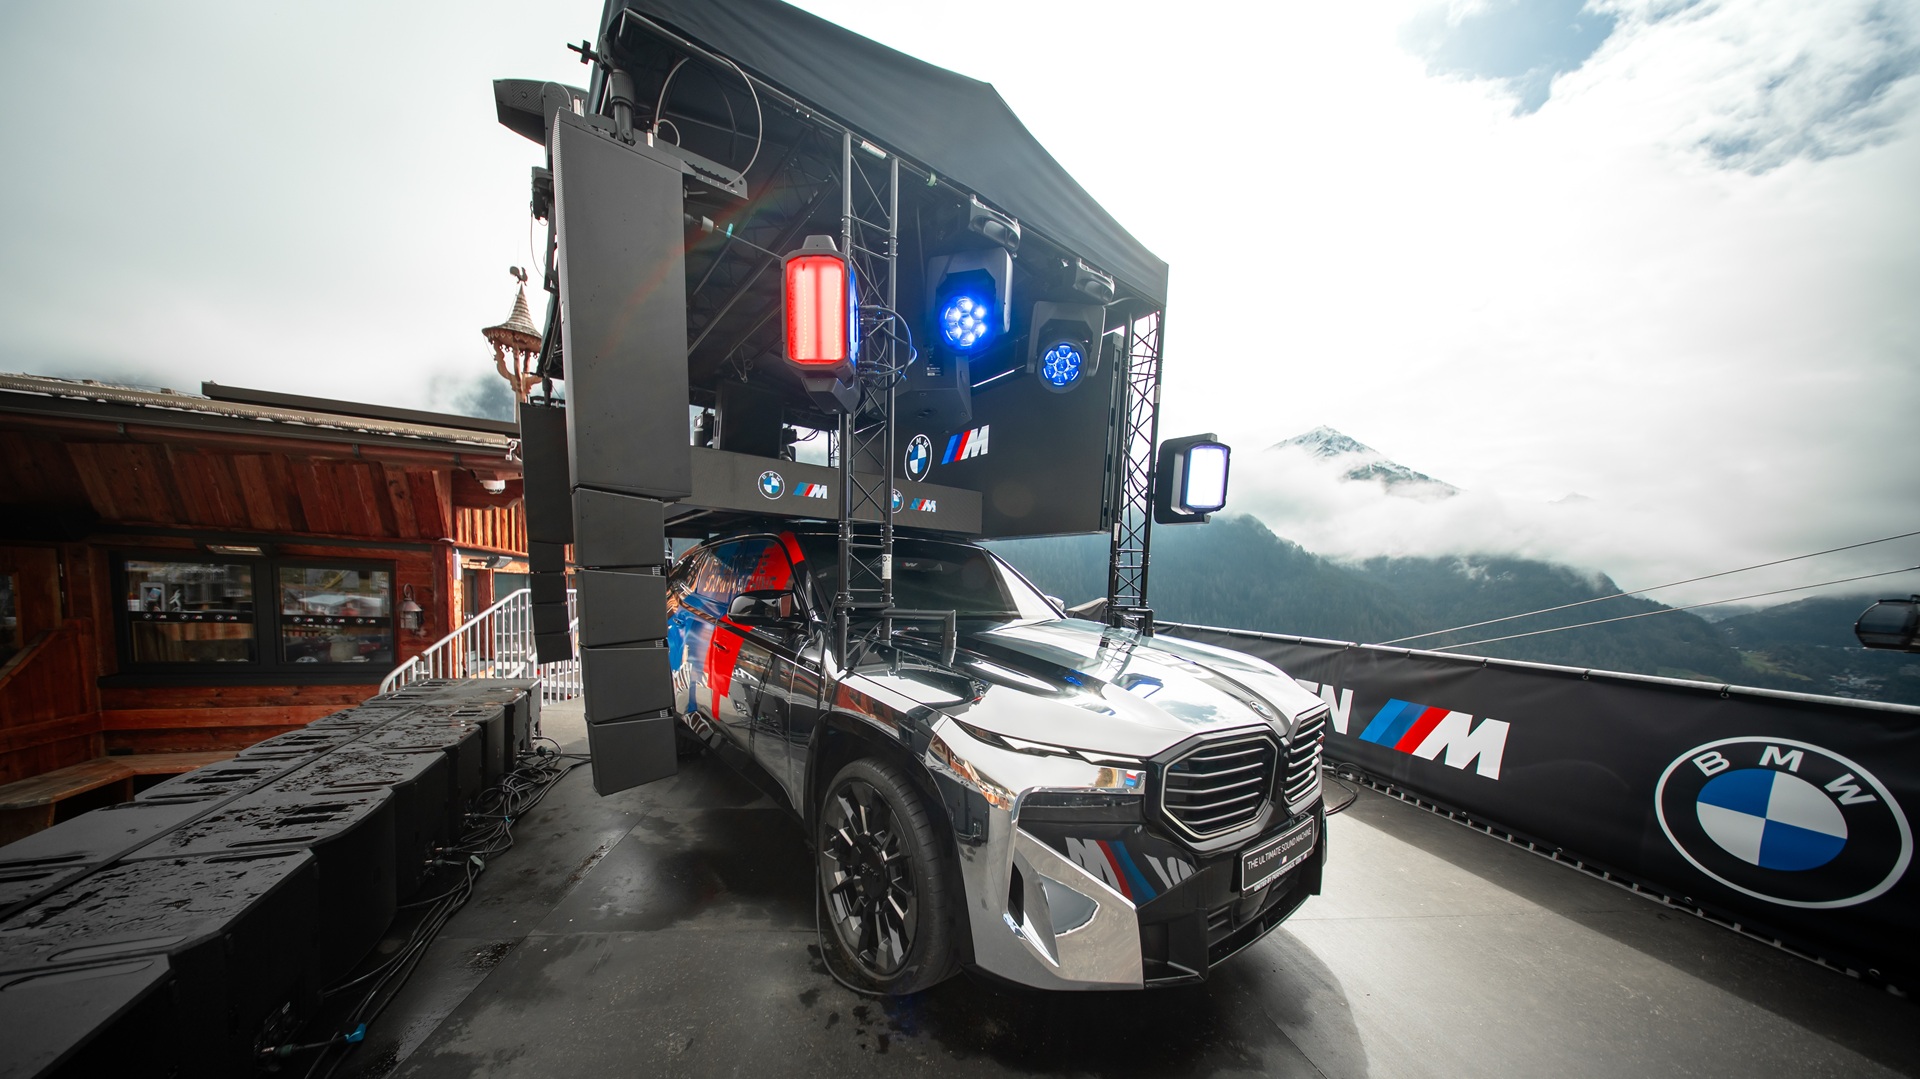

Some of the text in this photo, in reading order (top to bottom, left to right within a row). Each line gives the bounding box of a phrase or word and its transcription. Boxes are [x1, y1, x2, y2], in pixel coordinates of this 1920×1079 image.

[808, 483, 828, 500] M
[1412, 710, 1511, 781] M
[1692, 745, 1877, 806] BMW
[1247, 857, 1258, 870] THE
[1260, 846, 1282, 865] ULTIMATE
[1281, 838, 1296, 853] SOUND
[1296, 827, 1312, 843] MACHINE
